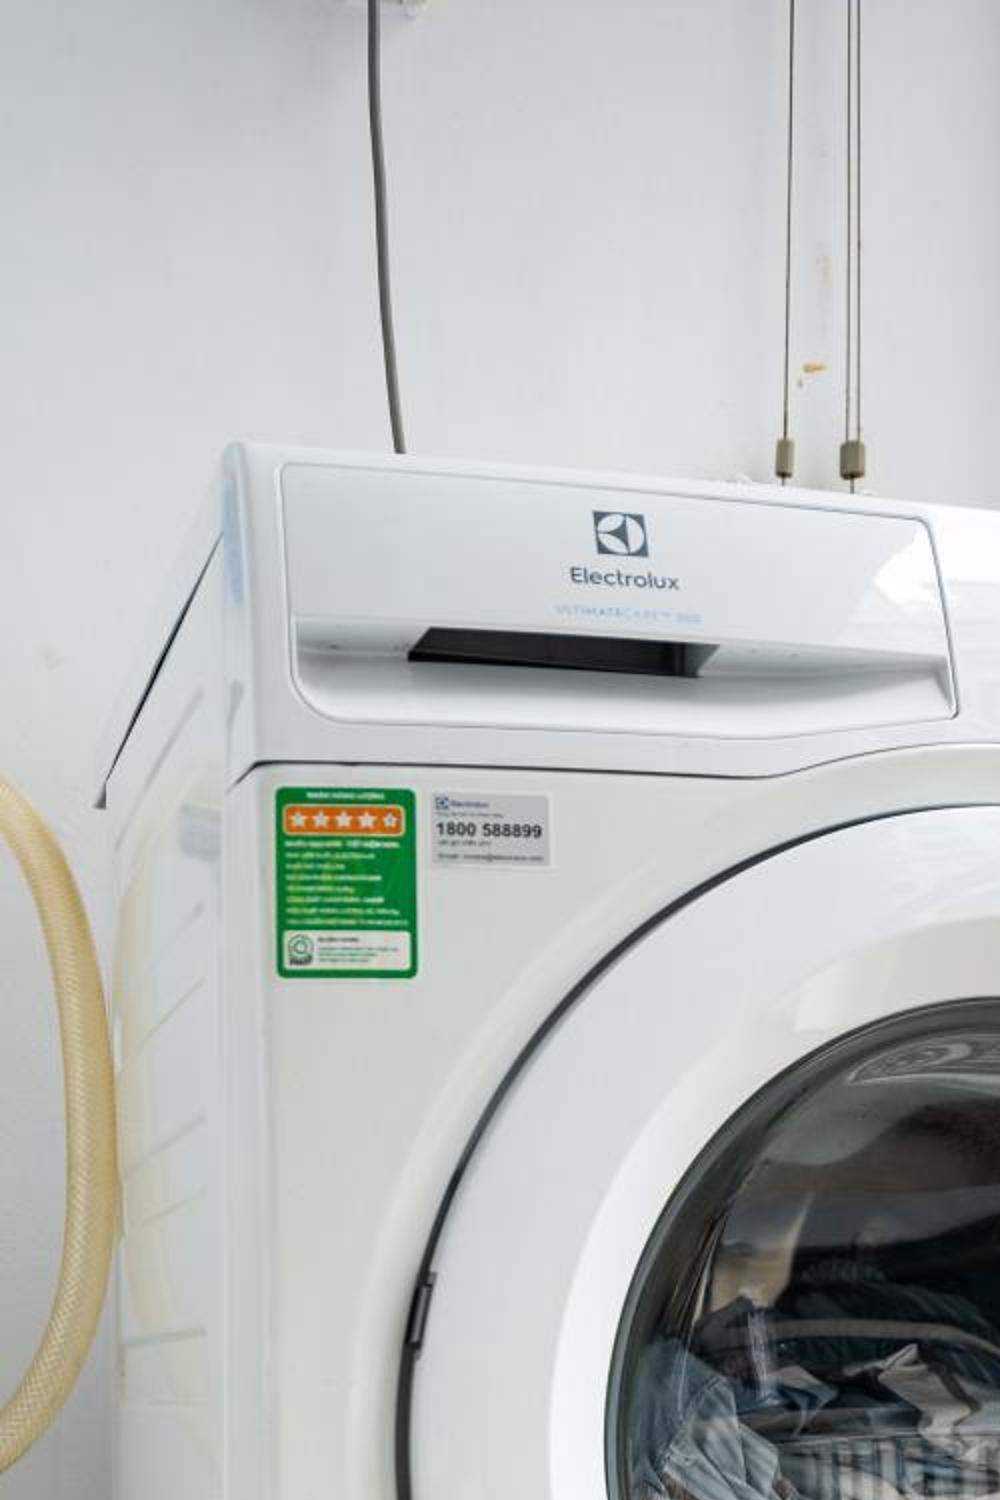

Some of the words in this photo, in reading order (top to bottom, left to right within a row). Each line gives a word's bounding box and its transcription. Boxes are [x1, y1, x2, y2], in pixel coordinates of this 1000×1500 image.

[570, 566, 680, 591] Electrolux
[437, 821, 477, 837] 1800
[482, 822, 543, 839] 588899
